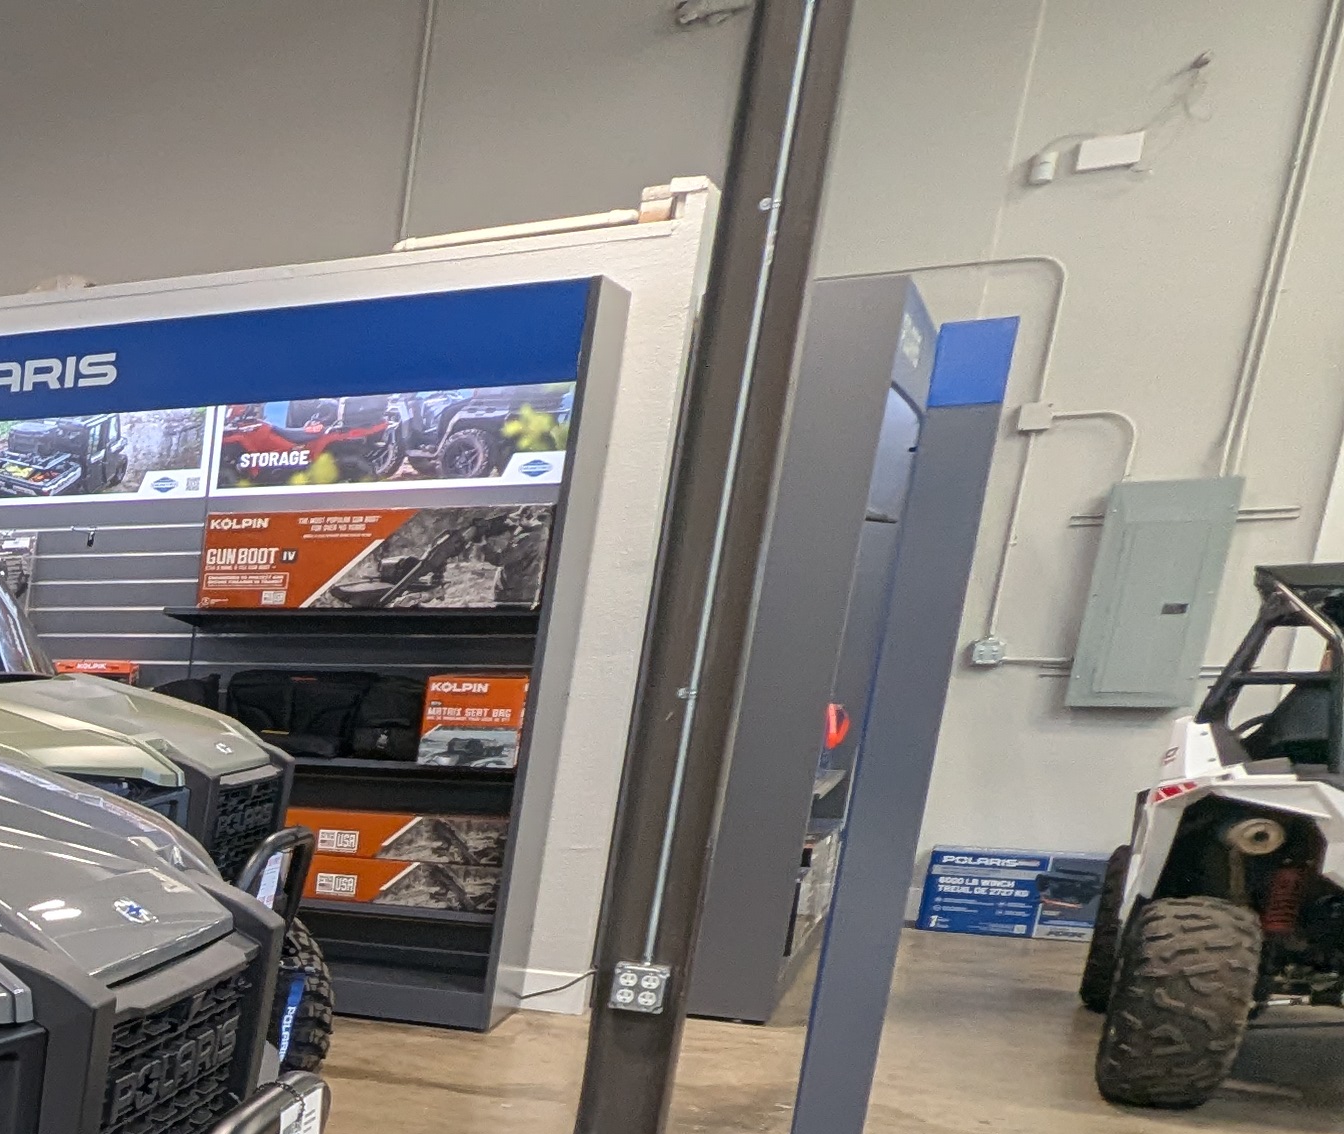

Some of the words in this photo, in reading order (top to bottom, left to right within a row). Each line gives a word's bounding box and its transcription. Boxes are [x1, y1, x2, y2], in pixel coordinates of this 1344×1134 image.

[240, 450, 310, 468] STORAGE
[210, 517, 270, 531] KOLPIN
[282, 550, 297, 561] IV
[76, 662, 108, 670] KOLPIN
[430, 681, 490, 693] KOLPIN
[337, 833, 356, 848] USA
[942, 855, 1018, 868] POLARIS
[334, 877, 354, 892] USA
[113, 1014, 240, 1121] POLARIS
